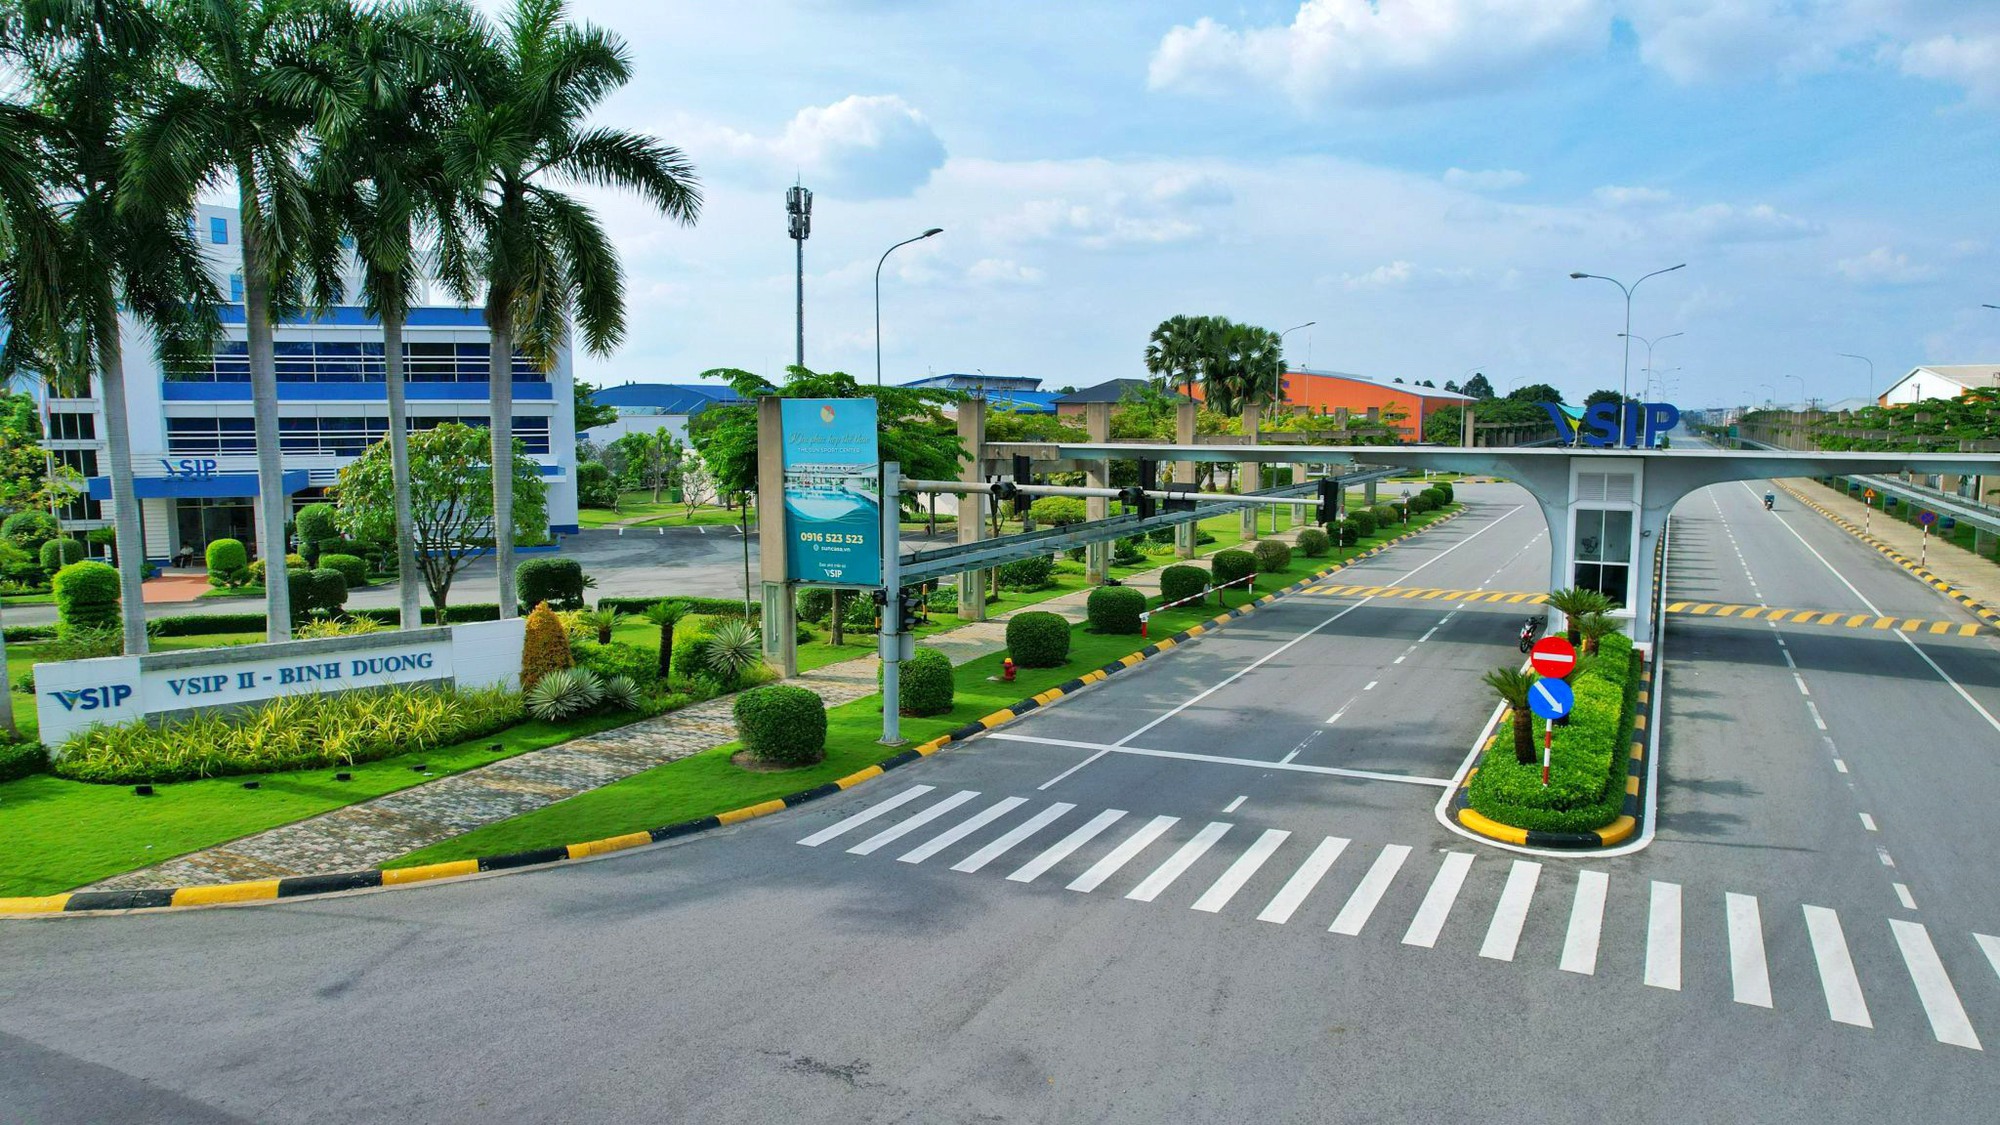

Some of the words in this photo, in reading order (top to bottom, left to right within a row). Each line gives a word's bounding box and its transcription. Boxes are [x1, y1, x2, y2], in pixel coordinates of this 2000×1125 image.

[1534, 402, 1680, 447] VSIP
[158, 459, 217, 477] VSIP
[801, 532, 823, 542] 0916
[825, 533, 843, 543] 523
[845, 534, 864, 544] 523
[824, 568, 843, 578] VSIP
[167, 675, 228, 695] VSIP
[237, 671, 256, 689] II
[279, 662, 341, 685] BINH
[352, 652, 433, 677] DUONG
[47, 685, 132, 711] VSIP
